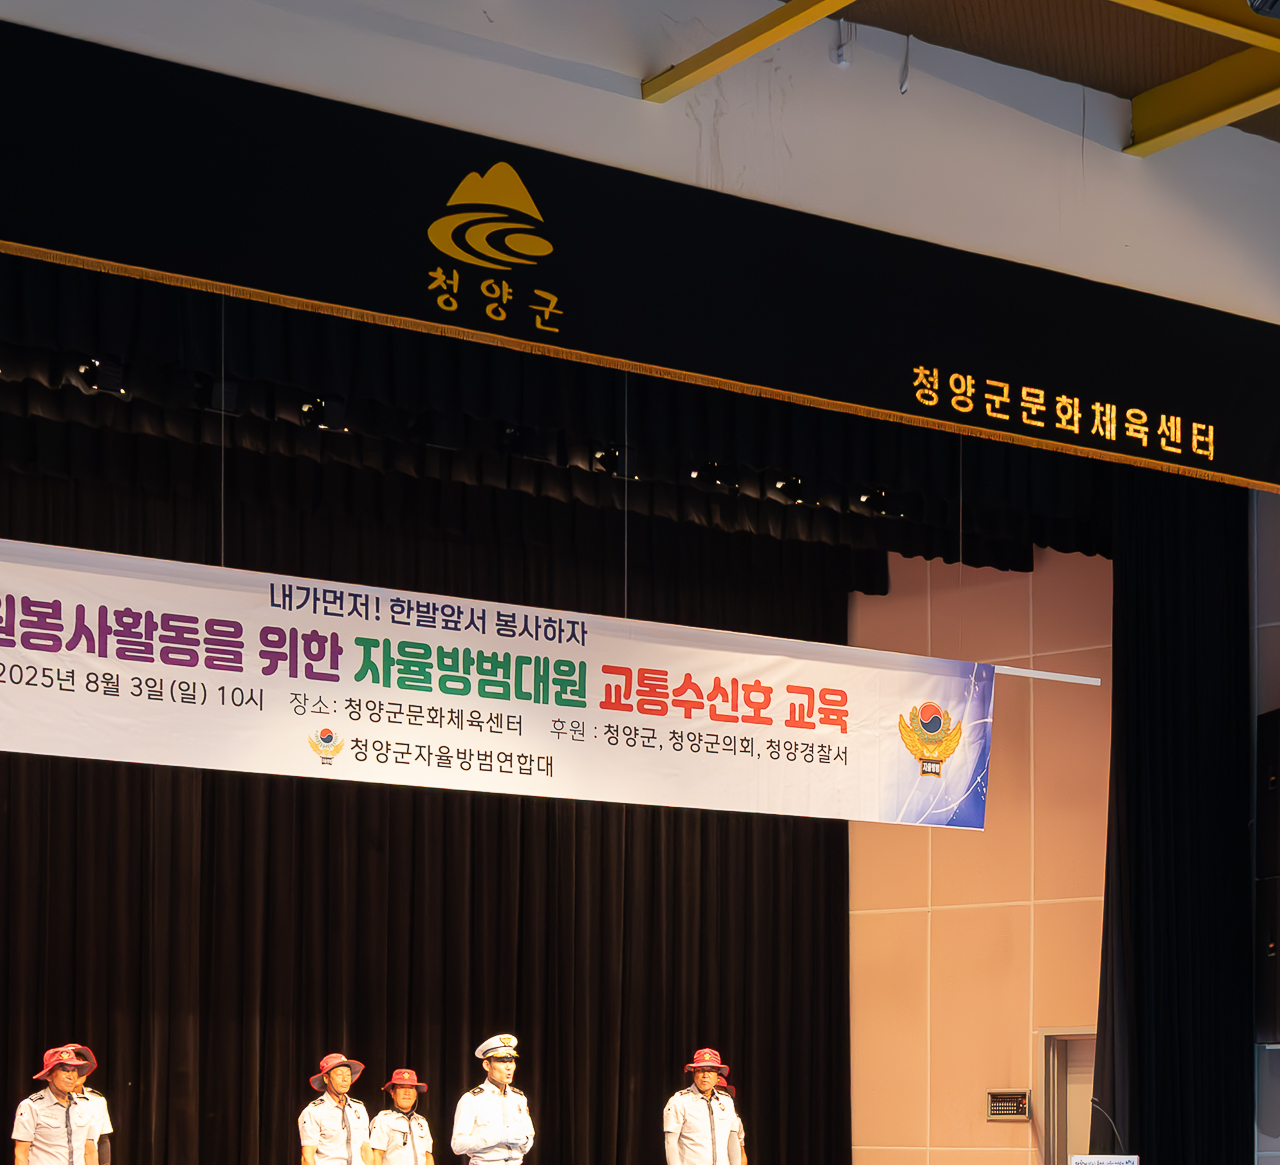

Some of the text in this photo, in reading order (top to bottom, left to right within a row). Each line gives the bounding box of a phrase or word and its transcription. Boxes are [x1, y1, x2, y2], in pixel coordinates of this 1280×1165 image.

[428, 267, 563, 332] 청양군
[913, 366, 1214, 460] 청양군문화체육센터
[270, 583, 587, 646] 내가먼저! 한발앞서 봉사하자
[86, 672, 119, 696] 8월
[218, 686, 263, 711] 10시
[345, 698, 521, 736] 청양군문화체육센터
[550, 718, 584, 741] 후원
[604, 724, 662, 751] 청양군,
[669, 730, 760, 759] 청양군의회,
[766, 739, 847, 765] 청양경찰서
[259, 626, 343, 682] 위한
[354, 637, 586, 708] 자율방범대원
[599, 665, 773, 725] 교통수신호
[785, 685, 849, 734] 교육
[351, 738, 552, 777] 청양군자율방범연합대
